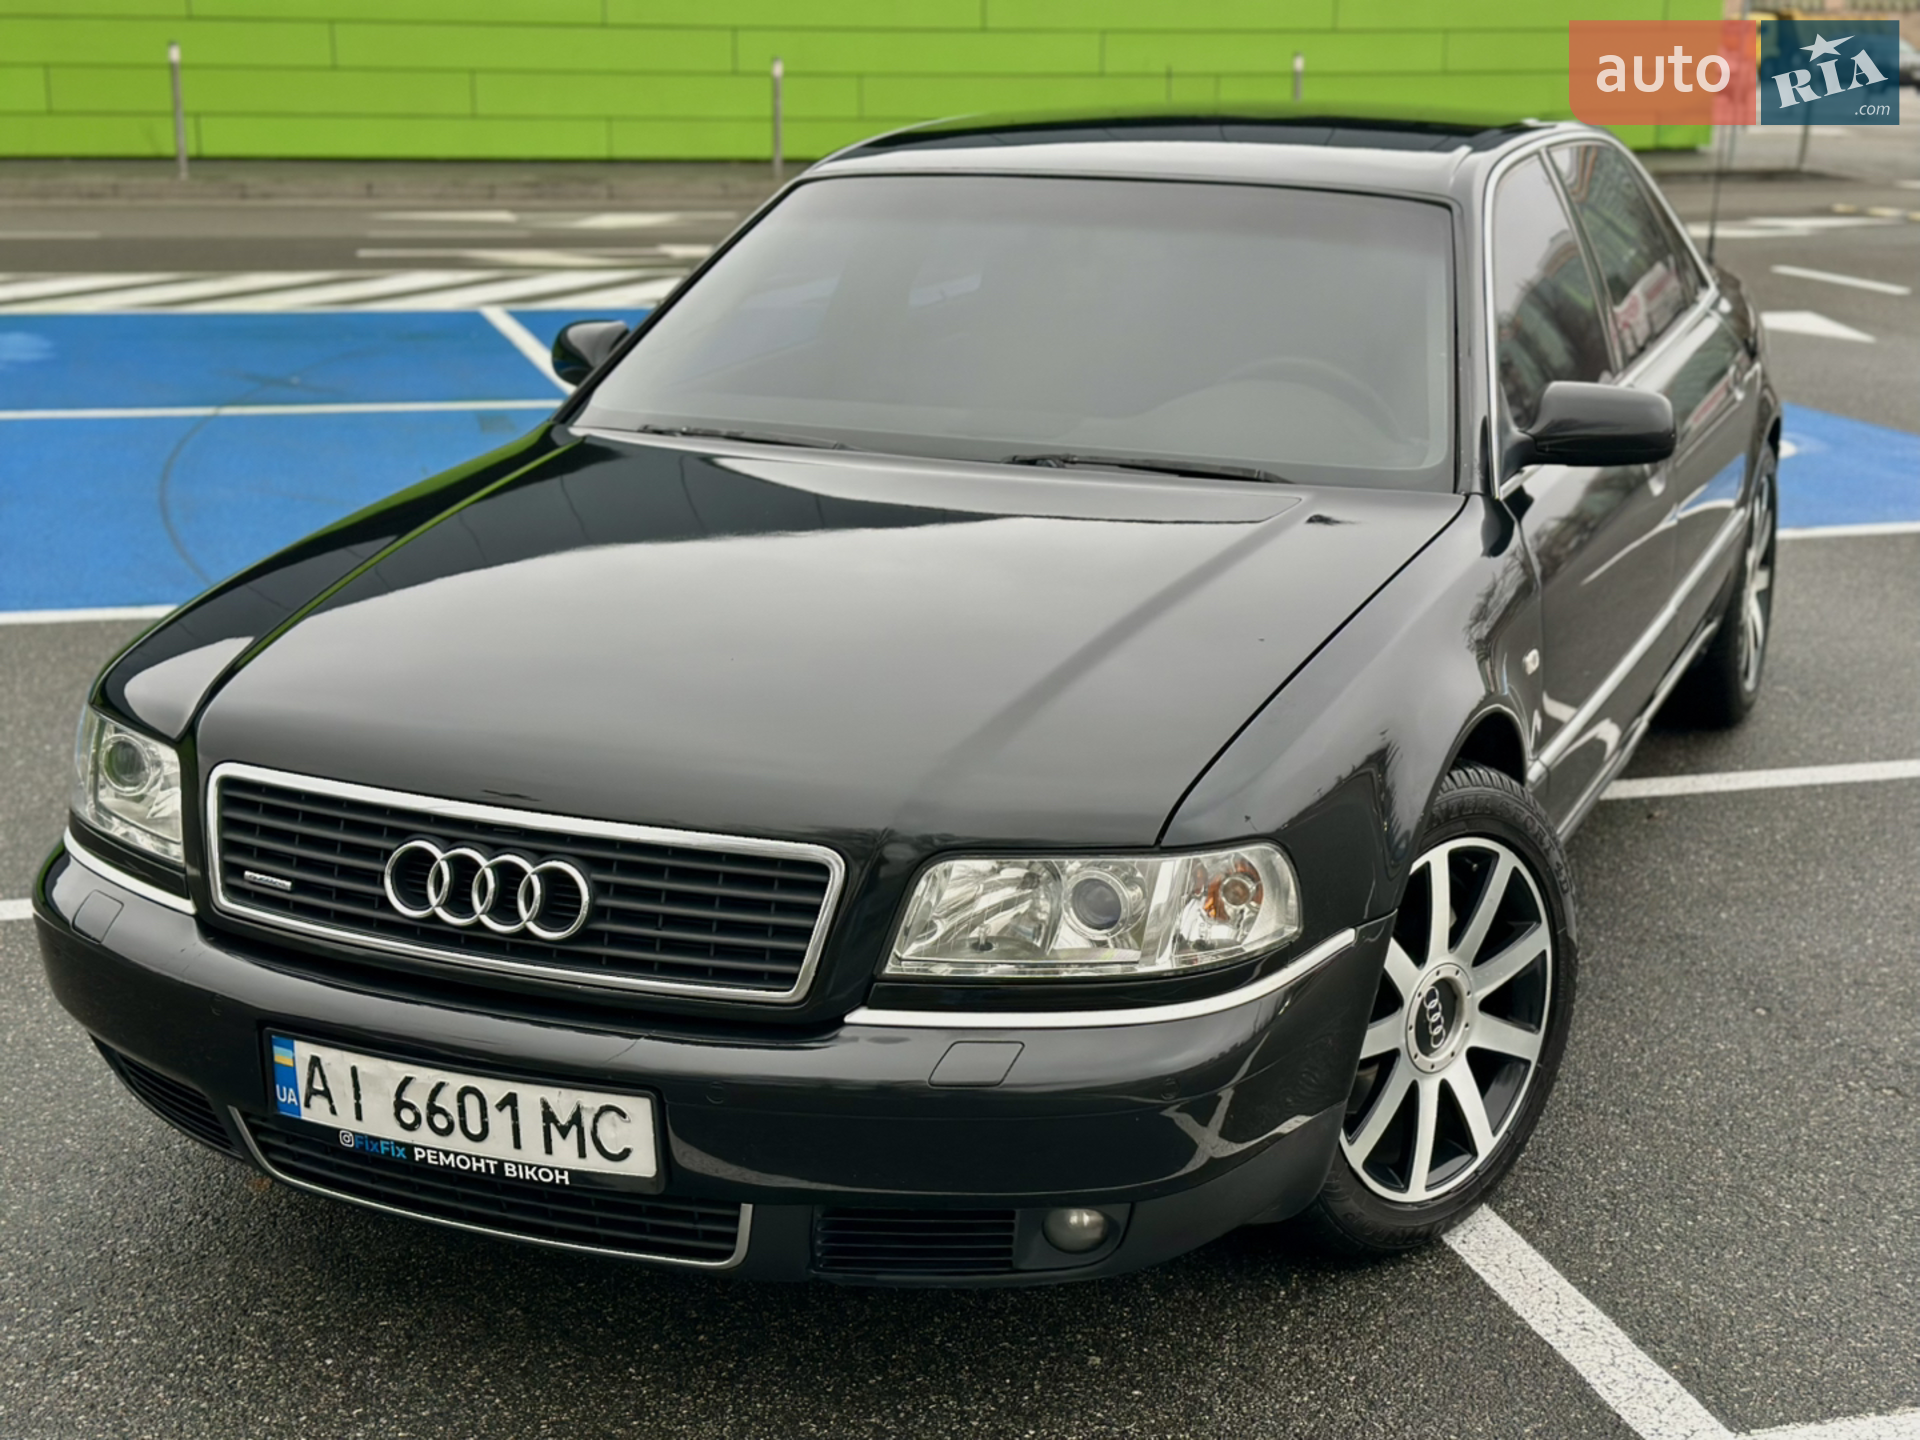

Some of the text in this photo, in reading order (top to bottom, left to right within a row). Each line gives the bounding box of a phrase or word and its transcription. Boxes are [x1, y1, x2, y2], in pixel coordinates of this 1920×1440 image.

[276, 1086, 298, 1106] UA
[303, 1054, 633, 1162] AI 6601 MC
[355, 1134, 570, 1186] FixFix РЕМОНТ ВІКОН
